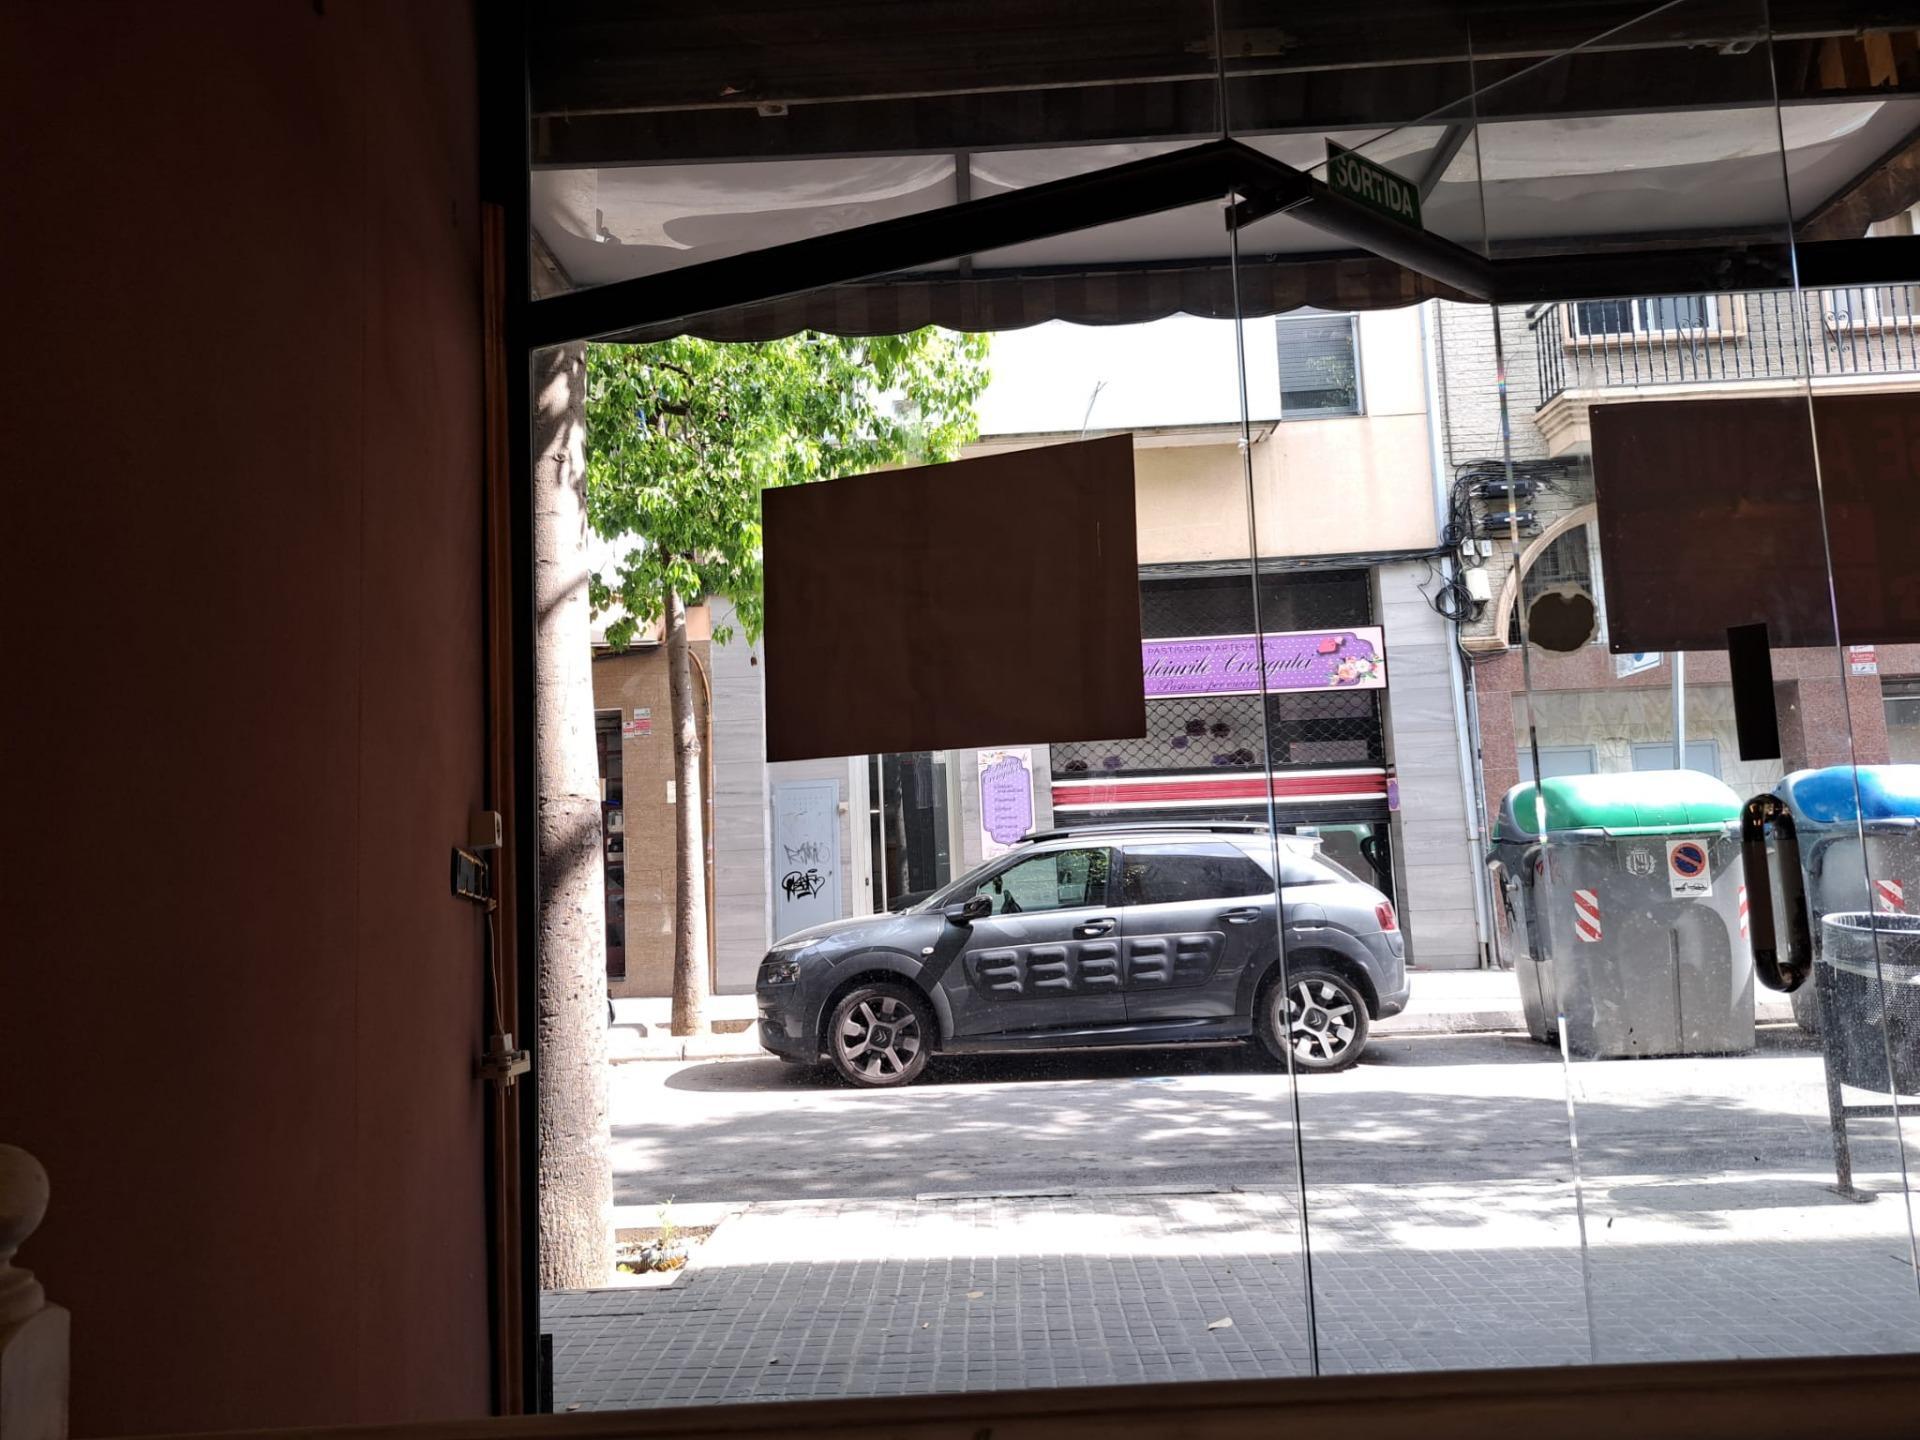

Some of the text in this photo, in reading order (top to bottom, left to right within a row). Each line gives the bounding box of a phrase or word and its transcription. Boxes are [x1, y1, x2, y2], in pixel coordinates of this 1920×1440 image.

[1336, 154, 1414, 219] SORTIDA
[1147, 642, 1276, 655] PASTISSERIA ARTESAAL
